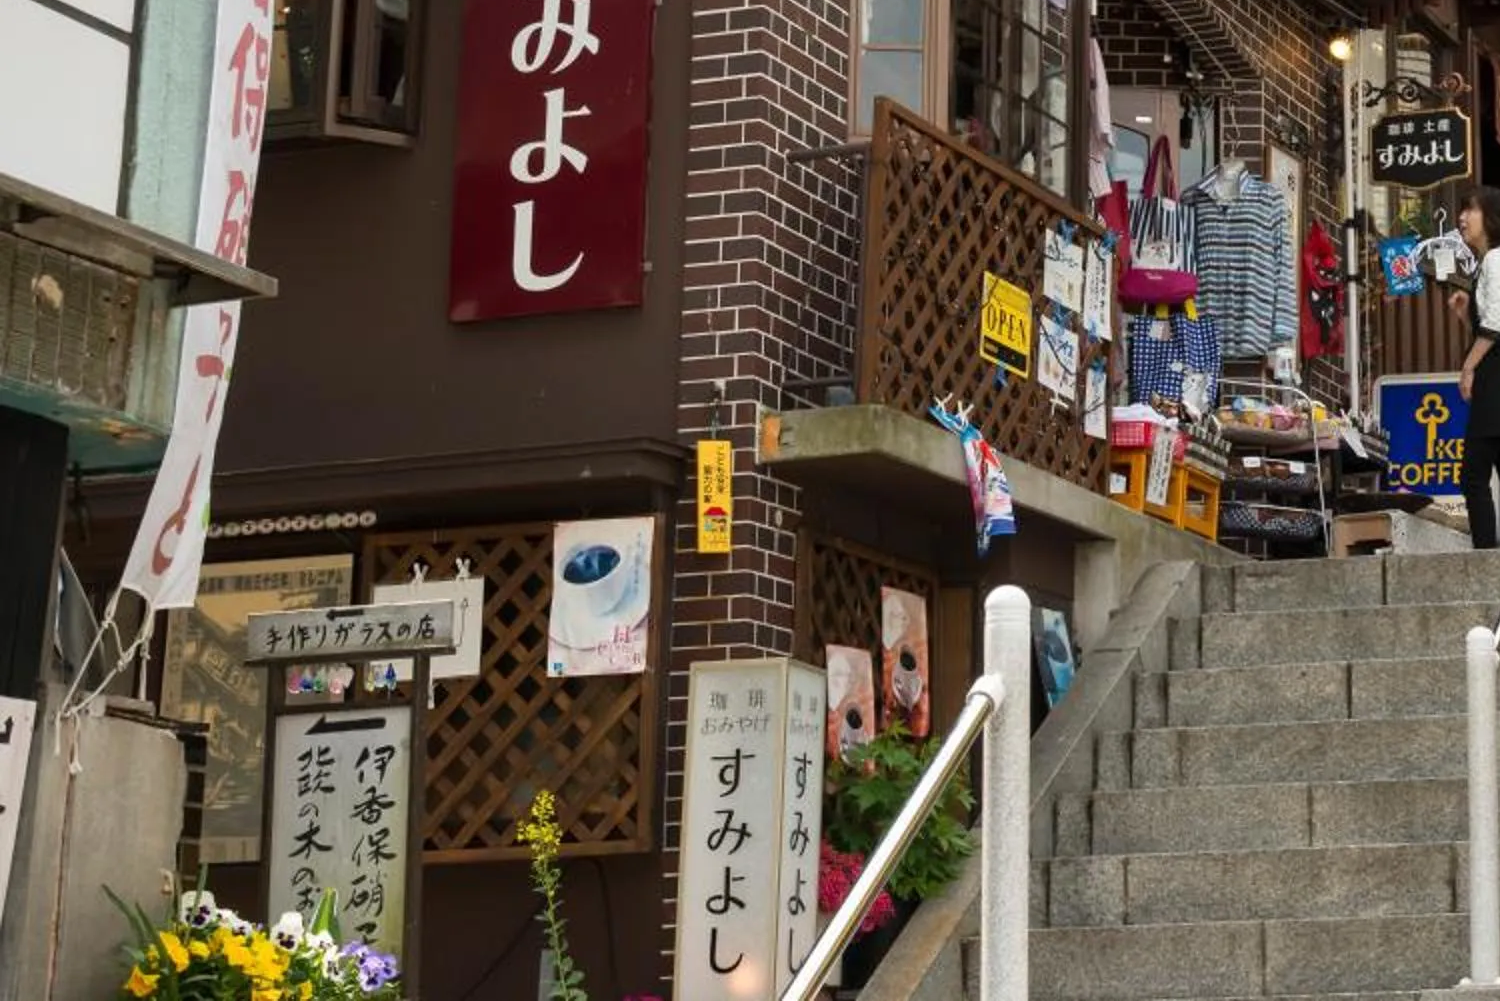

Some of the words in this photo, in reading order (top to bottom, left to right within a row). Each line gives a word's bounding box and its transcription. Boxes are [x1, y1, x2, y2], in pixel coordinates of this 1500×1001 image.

[1375, 139, 1465, 170] すみよし
[986, 303, 1027, 348] OPEN
[1388, 462, 1464, 486] COFFE
[265, 613, 437, 654] 手作りガラスの店
[700, 714, 771, 736] おみやげ
[705, 748, 757, 975] すみよし
[787, 752, 813, 976] すみよし
